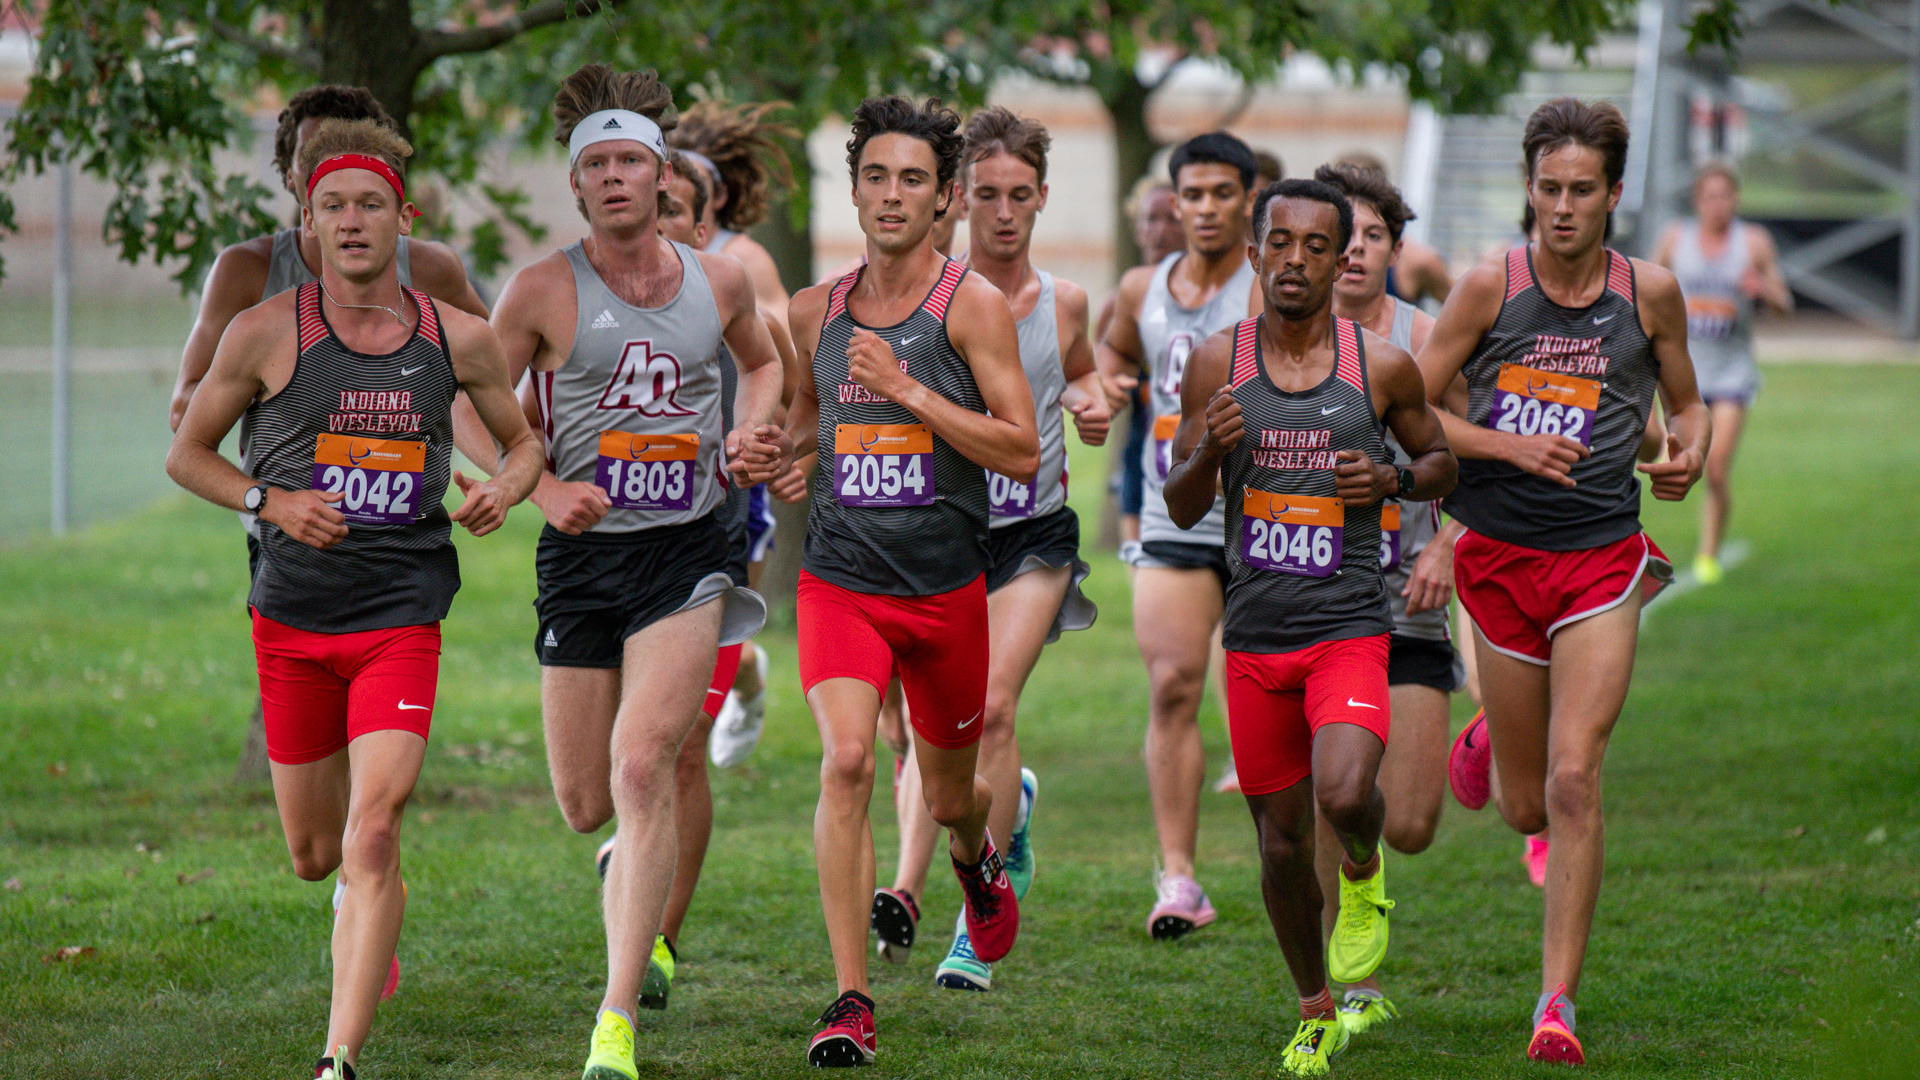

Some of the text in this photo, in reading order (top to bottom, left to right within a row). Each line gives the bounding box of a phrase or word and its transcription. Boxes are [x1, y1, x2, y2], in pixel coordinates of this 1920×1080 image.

[591, 320, 620, 329] adidas
[1534, 334, 1602, 354] INDIANA
[1521, 353, 1610, 375] WESLEYAN
[595, 338, 703, 420] AQ
[339, 390, 411, 411] INDIANA
[328, 413, 422, 432] WESLEYAN
[1496, 393, 1585, 443] 2062
[1260, 429, 1331, 448] INDIANA
[1251, 450, 1338, 469] WESLEYAN
[607, 459, 687, 501] 1803
[841, 454, 926, 497] 2054
[322, 465, 414, 514] 2042
[1249, 518, 1333, 567] 2046
